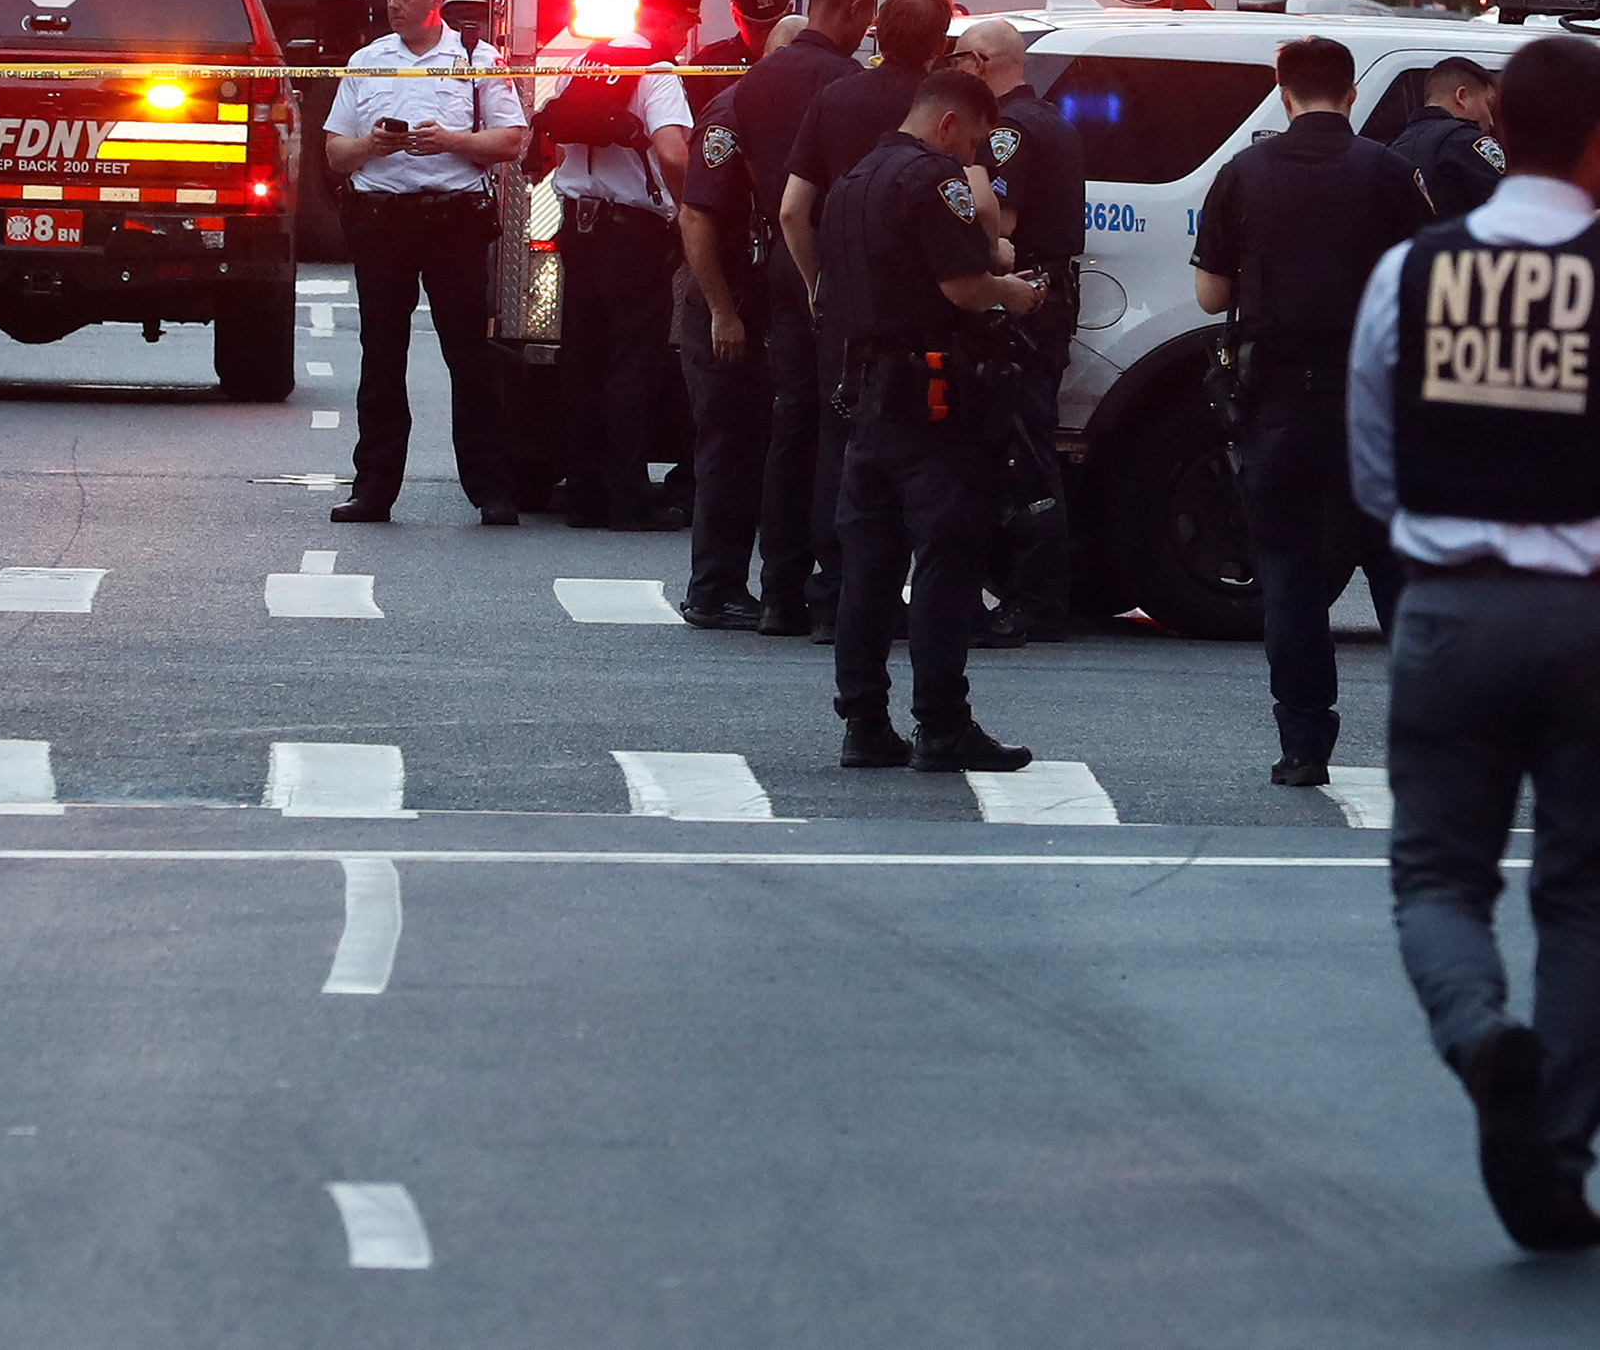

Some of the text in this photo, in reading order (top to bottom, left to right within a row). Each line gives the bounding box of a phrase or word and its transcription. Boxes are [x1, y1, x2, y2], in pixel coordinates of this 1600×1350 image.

[18, 159, 58, 172] BACK
[64, 161, 90, 174] 200
[95, 162, 130, 175] FEET
[33, 214, 81, 242] 8 BN
[1135, 218, 1146, 233] 17
[1426, 250, 1596, 326] NYPD
[1424, 330, 1591, 390] POLICE
